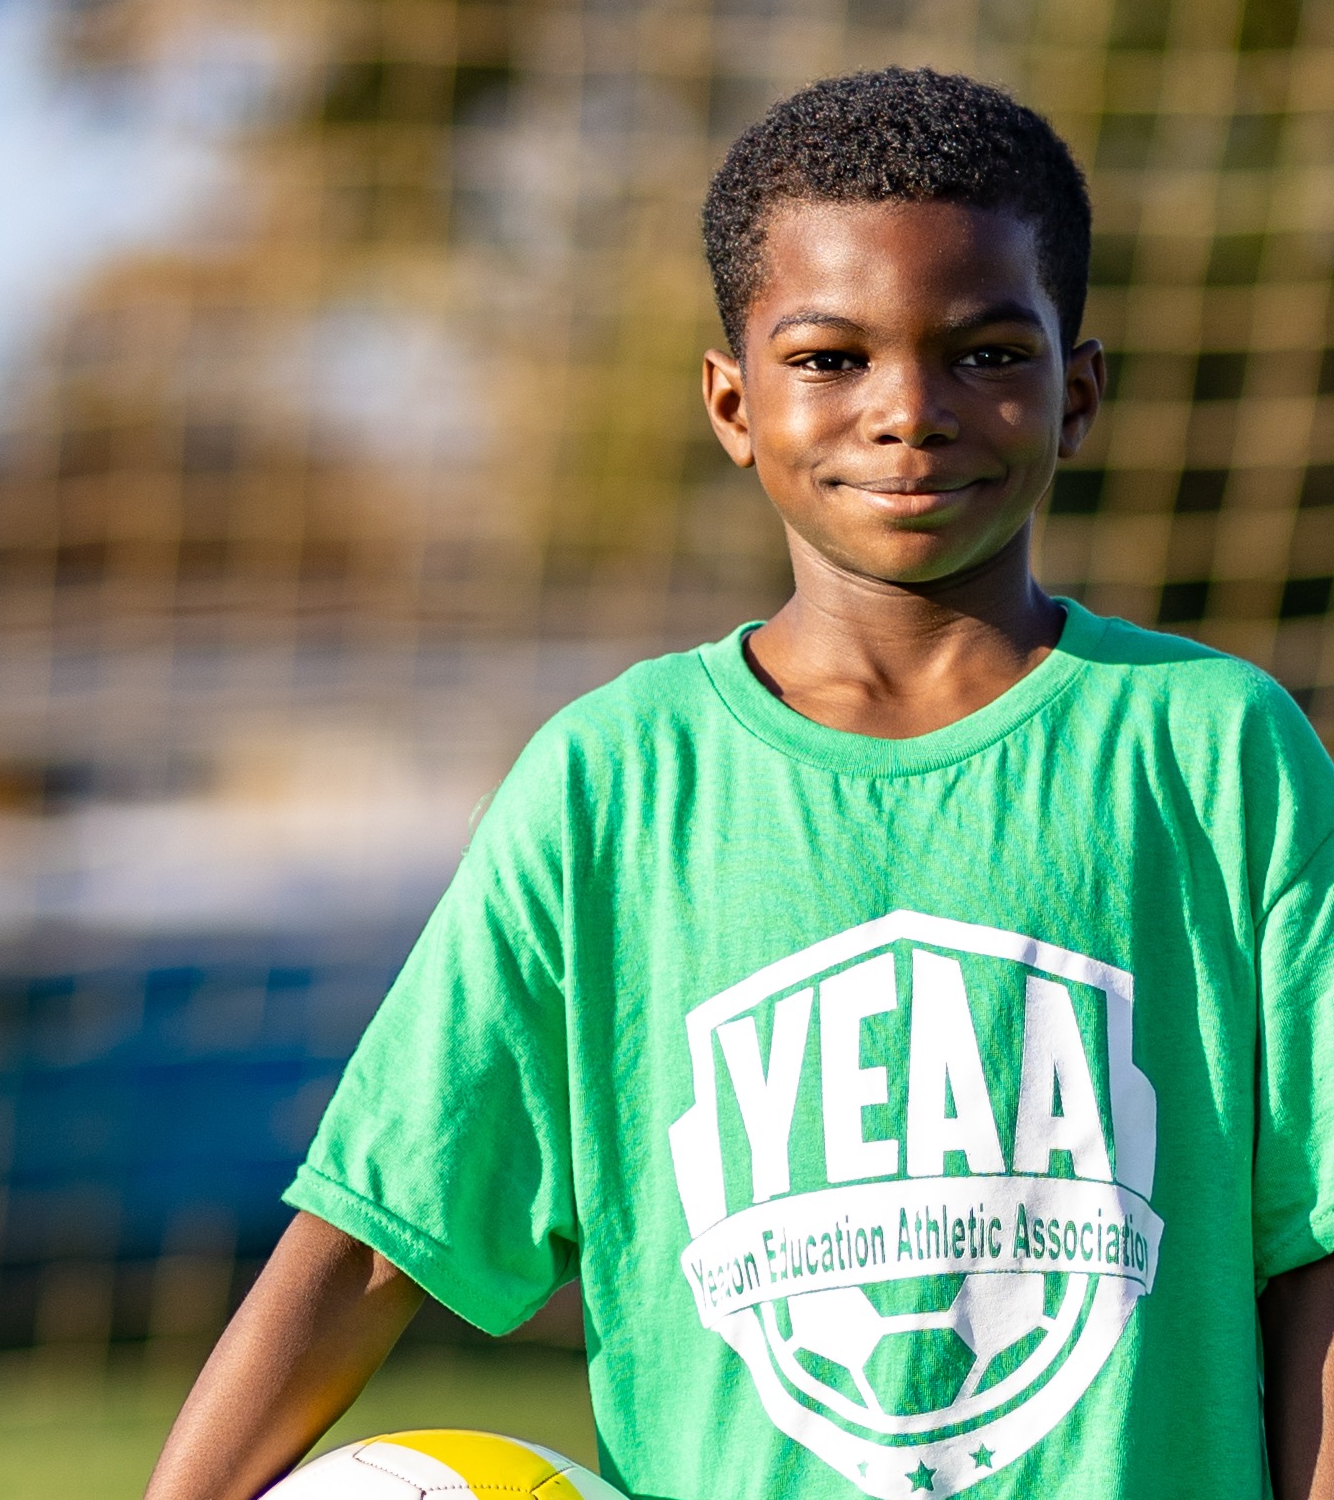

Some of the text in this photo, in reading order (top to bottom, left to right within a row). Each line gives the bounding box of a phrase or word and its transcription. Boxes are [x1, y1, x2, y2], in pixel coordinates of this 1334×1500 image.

[716, 947, 1114, 1203] YEAA
[762, 1215, 886, 1283] Education
[896, 1204, 1001, 1262] Athletic
[1012, 1203, 1149, 1274] Association
